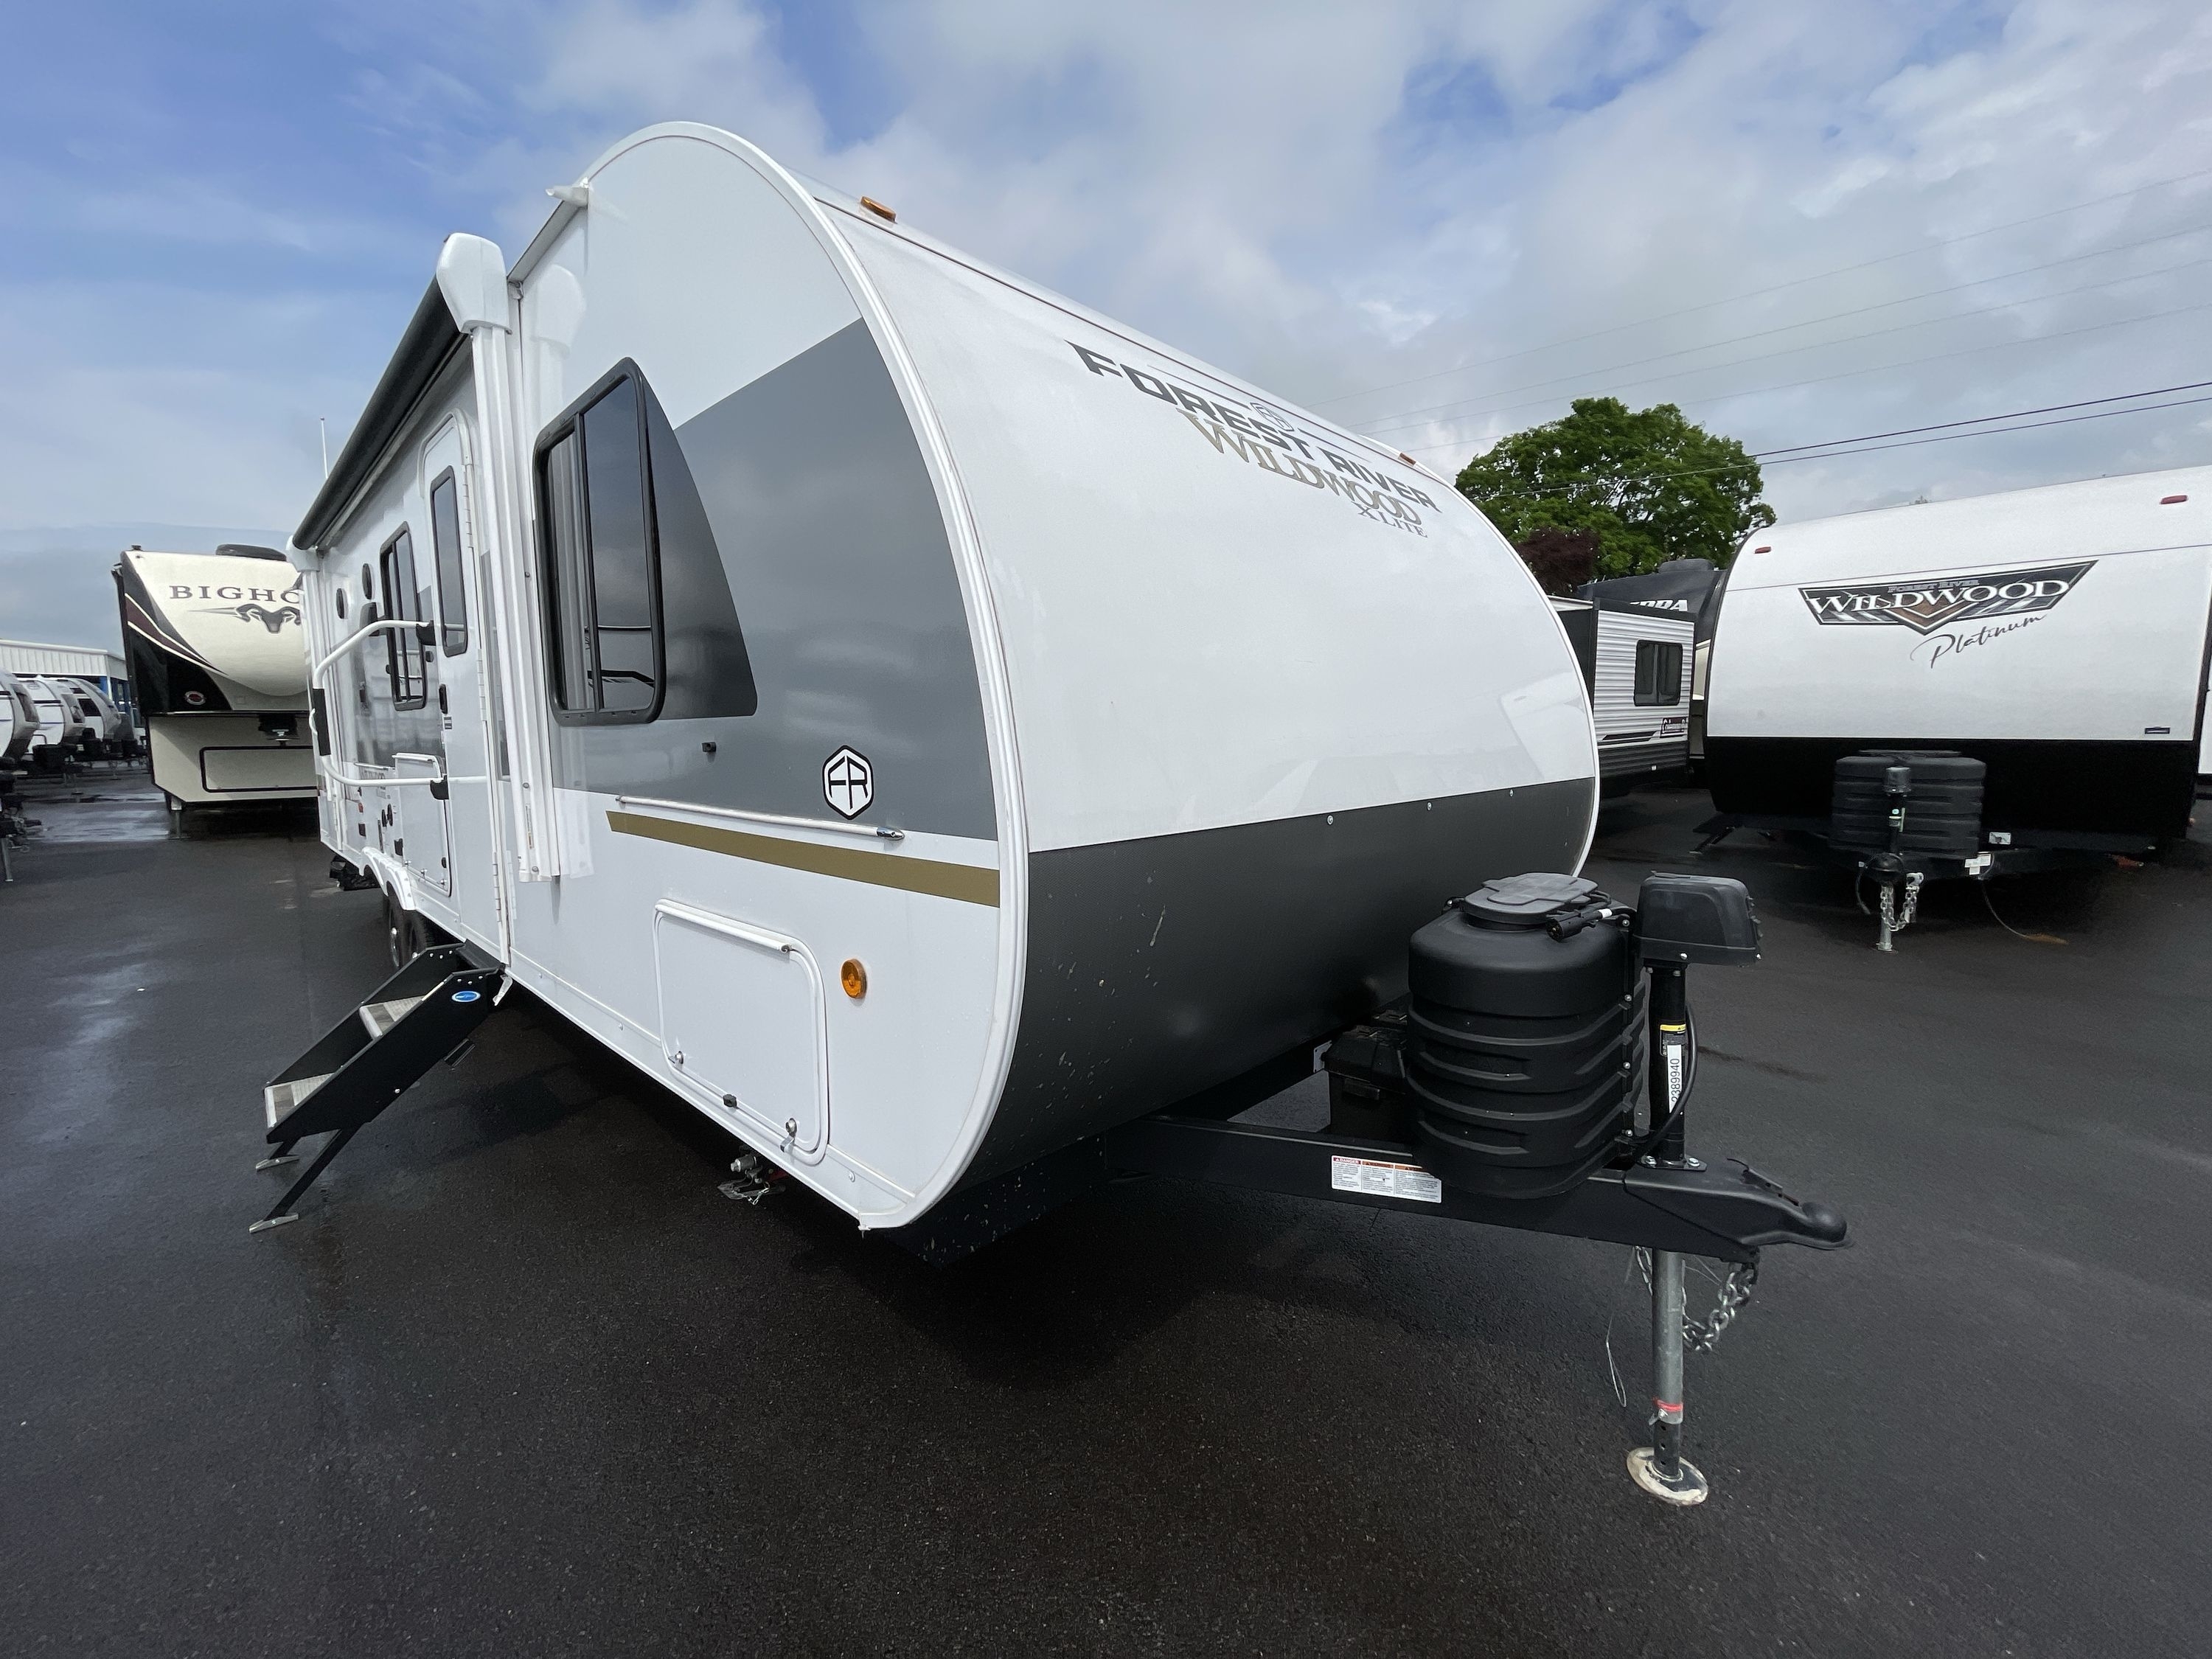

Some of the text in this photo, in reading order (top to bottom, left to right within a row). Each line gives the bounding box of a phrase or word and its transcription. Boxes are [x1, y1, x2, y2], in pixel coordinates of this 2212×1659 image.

[1064, 339, 1442, 513] FOREST RIVER
[1175, 407, 1422, 526] WILDWOOD
[1806, 580, 2070, 613] WILDWOOD
[1910, 614, 2047, 669] Platinum
[1669, 1058, 1680, 1102] 2389940
